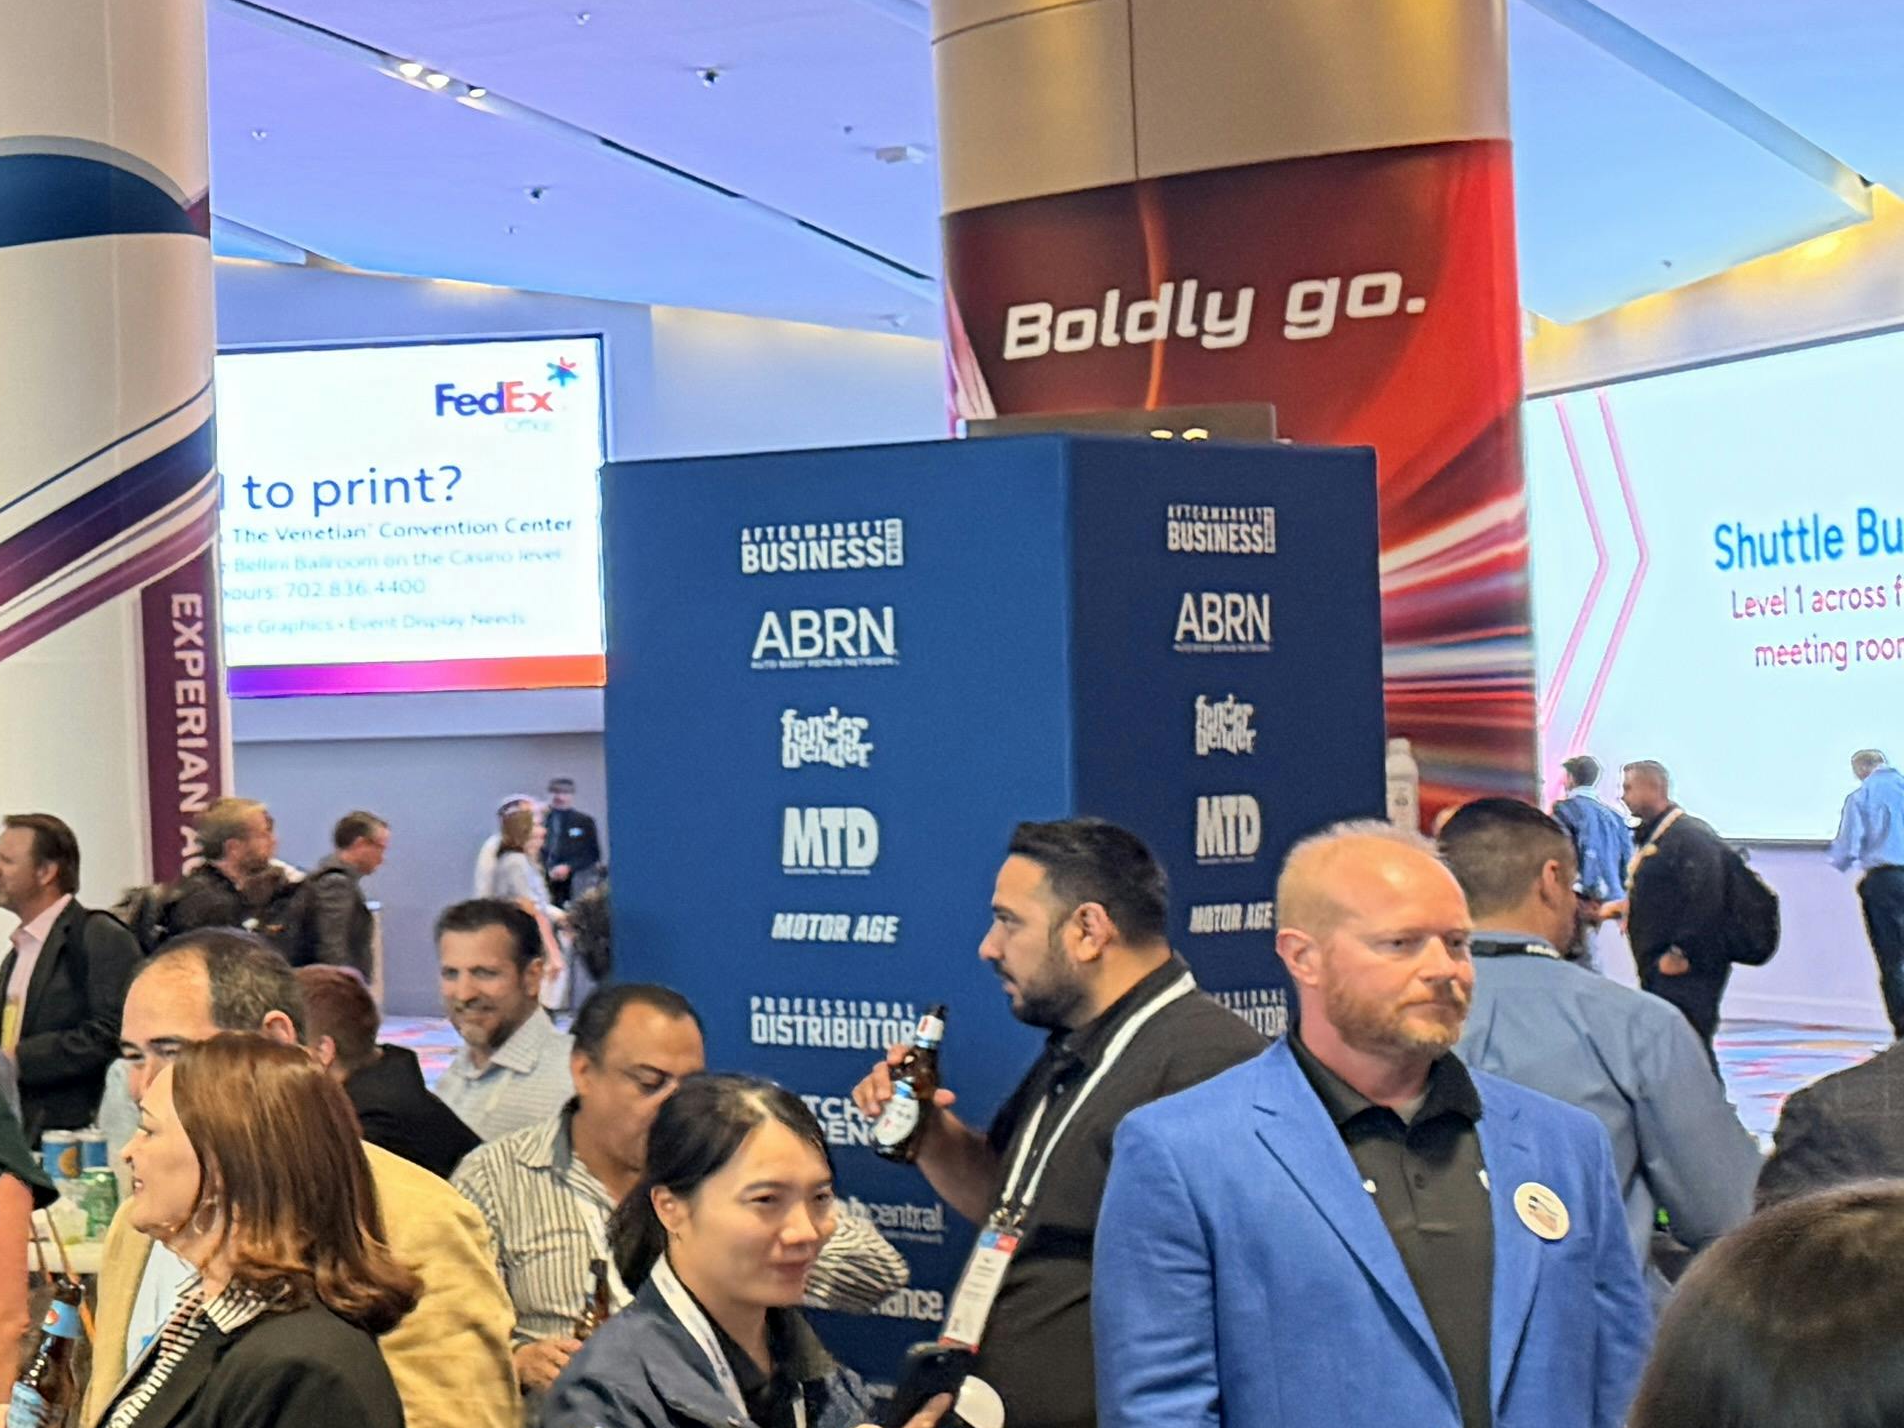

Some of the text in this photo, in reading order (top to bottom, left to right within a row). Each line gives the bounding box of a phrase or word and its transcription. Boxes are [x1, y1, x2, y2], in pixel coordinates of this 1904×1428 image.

[1002, 268, 1428, 361] Boldly go.
[435, 381, 554, 416] FedEx
[242, 475, 294, 510] to
[313, 465, 462, 517] print?
[233, 528, 269, 543] The
[379, 520, 498, 538] Convention
[505, 517, 572, 534] Center
[741, 520, 883, 543] AFTERMARKET
[1167, 521, 1264, 554] BUSINESS
[1715, 512, 1845, 571] Shuttle
[742, 536, 885, 574] BUSINESS
[1174, 591, 1271, 643] ABRN
[1732, 585, 1788, 619] Level
[1795, 584, 1804, 614] 1
[1811, 585, 1887, 613] across
[751, 605, 895, 660] ABRN
[1755, 632, 1848, 672] meeting
[171, 593, 210, 814] EXPERIAN
[782, 806, 879, 868] MTD
[1195, 794, 1261, 857] MTD
[770, 912, 900, 944] MOTOR AGE
[1189, 901, 1274, 934] MOTOR AGE
[750, 995, 916, 1020] PROFESSIONAL
[750, 1012, 918, 1050] DISTRIBUTOR
